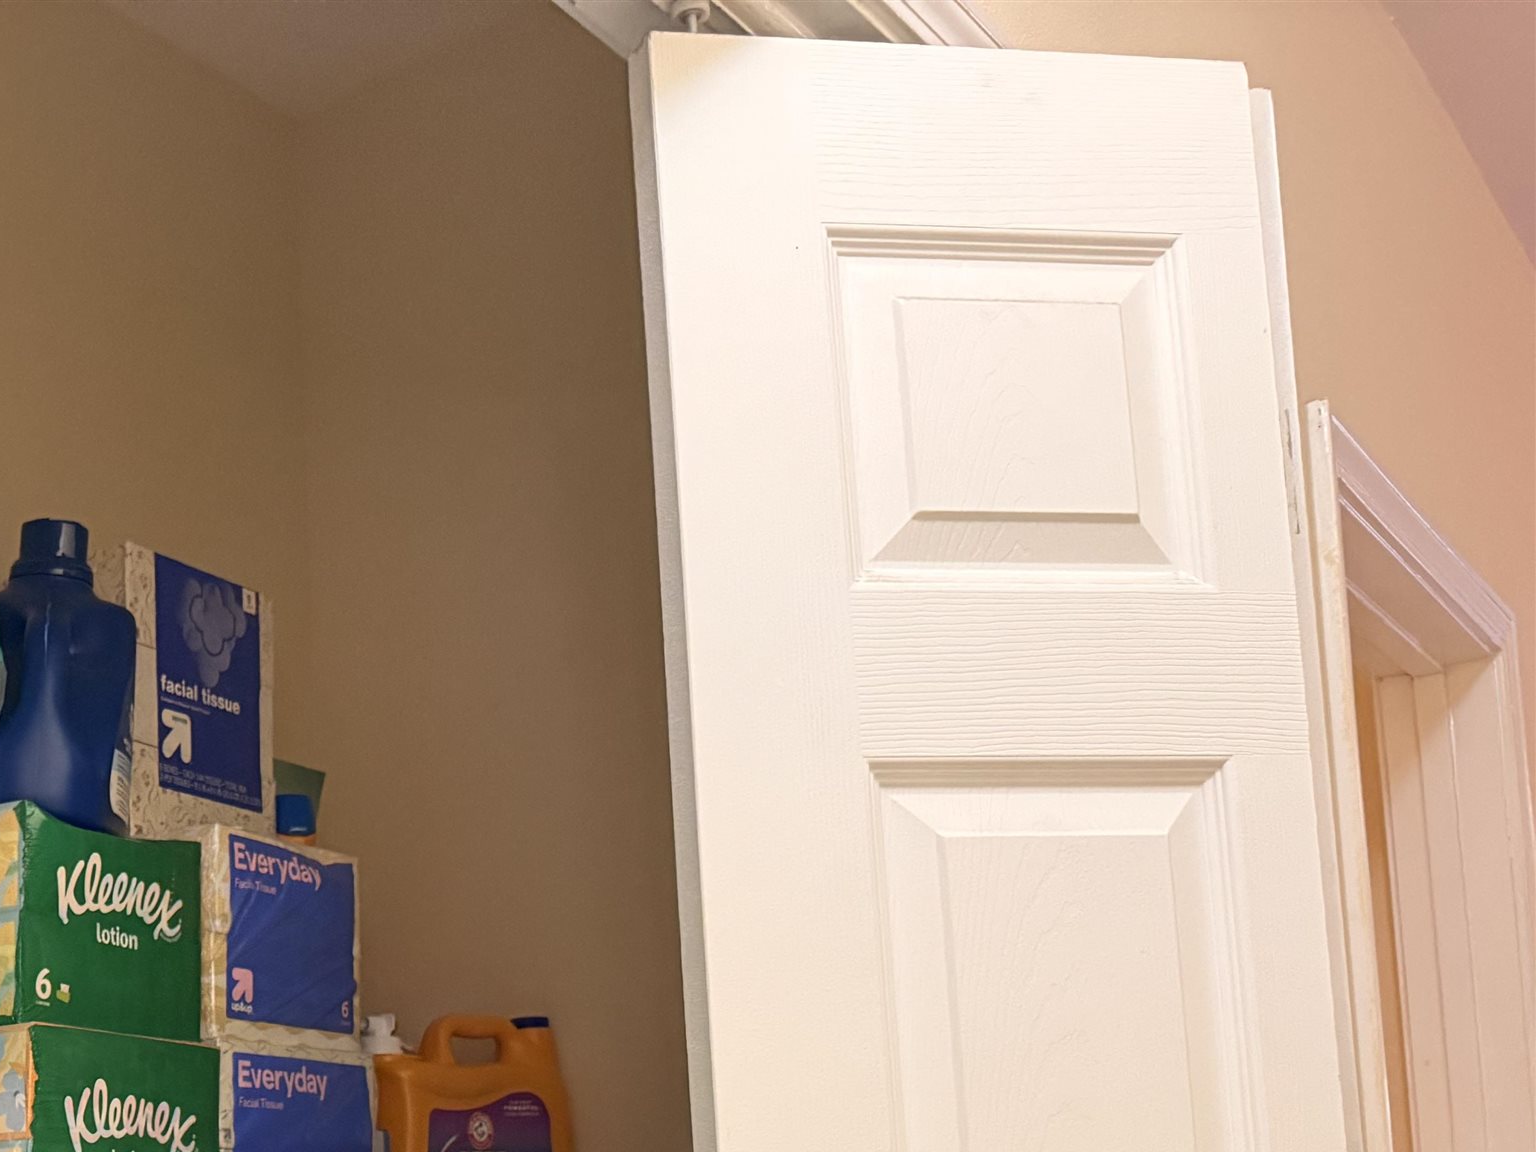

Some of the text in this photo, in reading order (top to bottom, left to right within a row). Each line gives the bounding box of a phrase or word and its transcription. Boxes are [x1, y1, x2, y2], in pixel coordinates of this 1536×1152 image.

[160, 674, 199, 700] facial
[202, 688, 241, 715] tissue
[233, 842, 322, 891] Everyday
[57, 852, 183, 941] Kleenex
[96, 922, 139, 951] lotion
[35, 968, 52, 1000] 6
[341, 1001, 349, 1018] 6
[237, 1060, 327, 1101] Everyday
